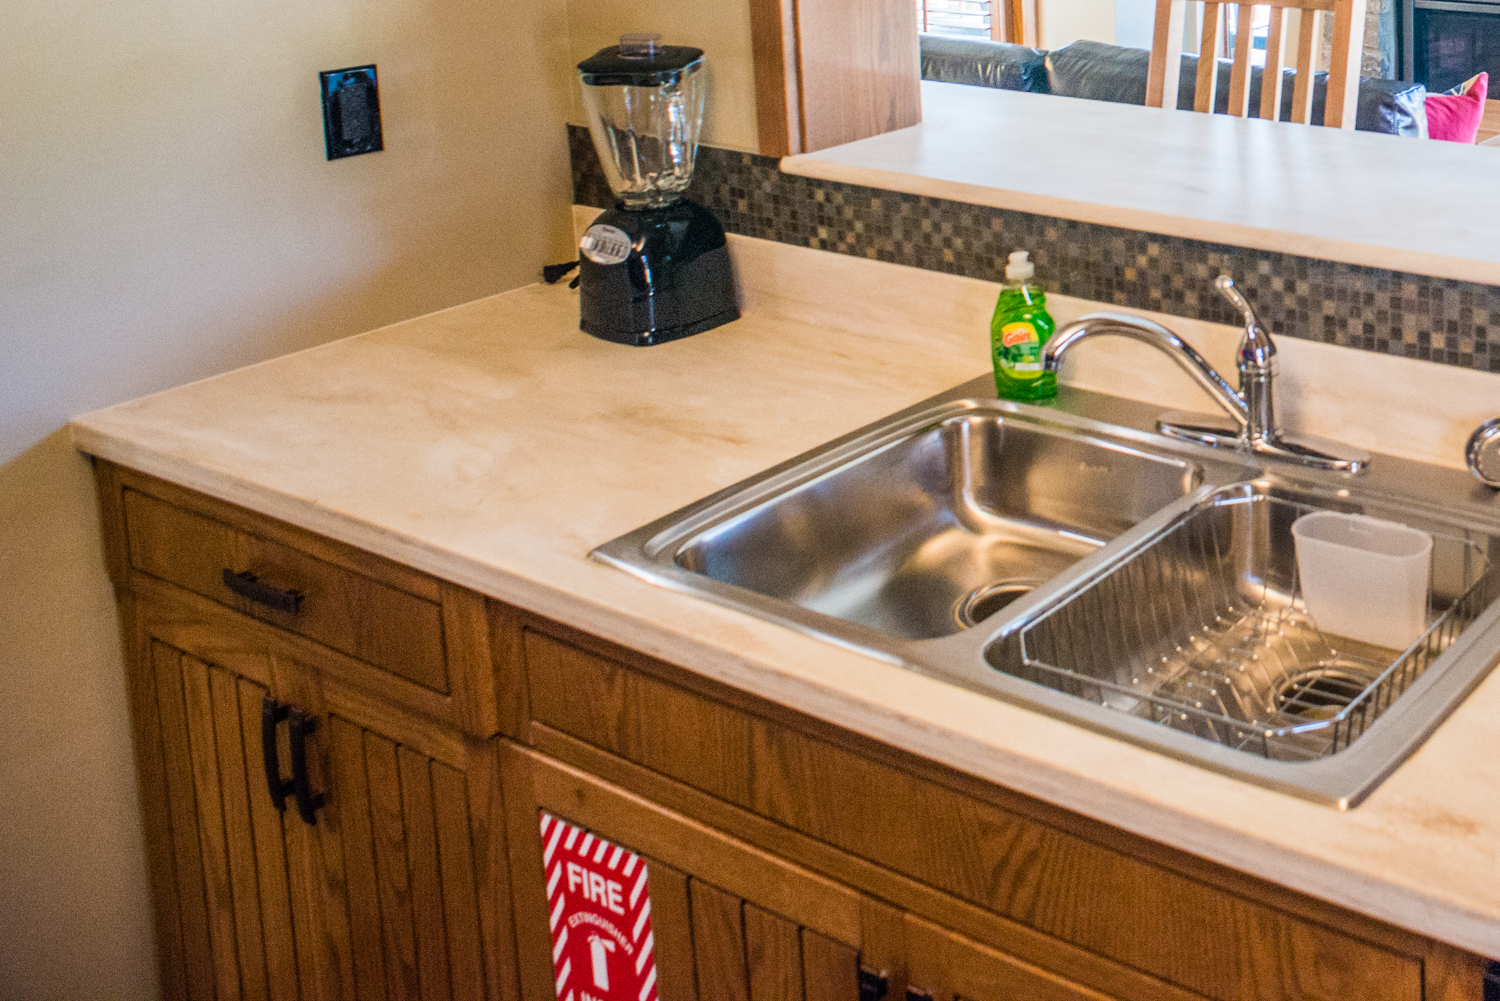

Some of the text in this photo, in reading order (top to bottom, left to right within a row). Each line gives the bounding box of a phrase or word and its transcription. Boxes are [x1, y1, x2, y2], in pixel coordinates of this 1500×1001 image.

[1003, 332, 1031, 347] Gain
[566, 861, 625, 916] FIRE
[567, 911, 634, 956] EXTINGUISHER
